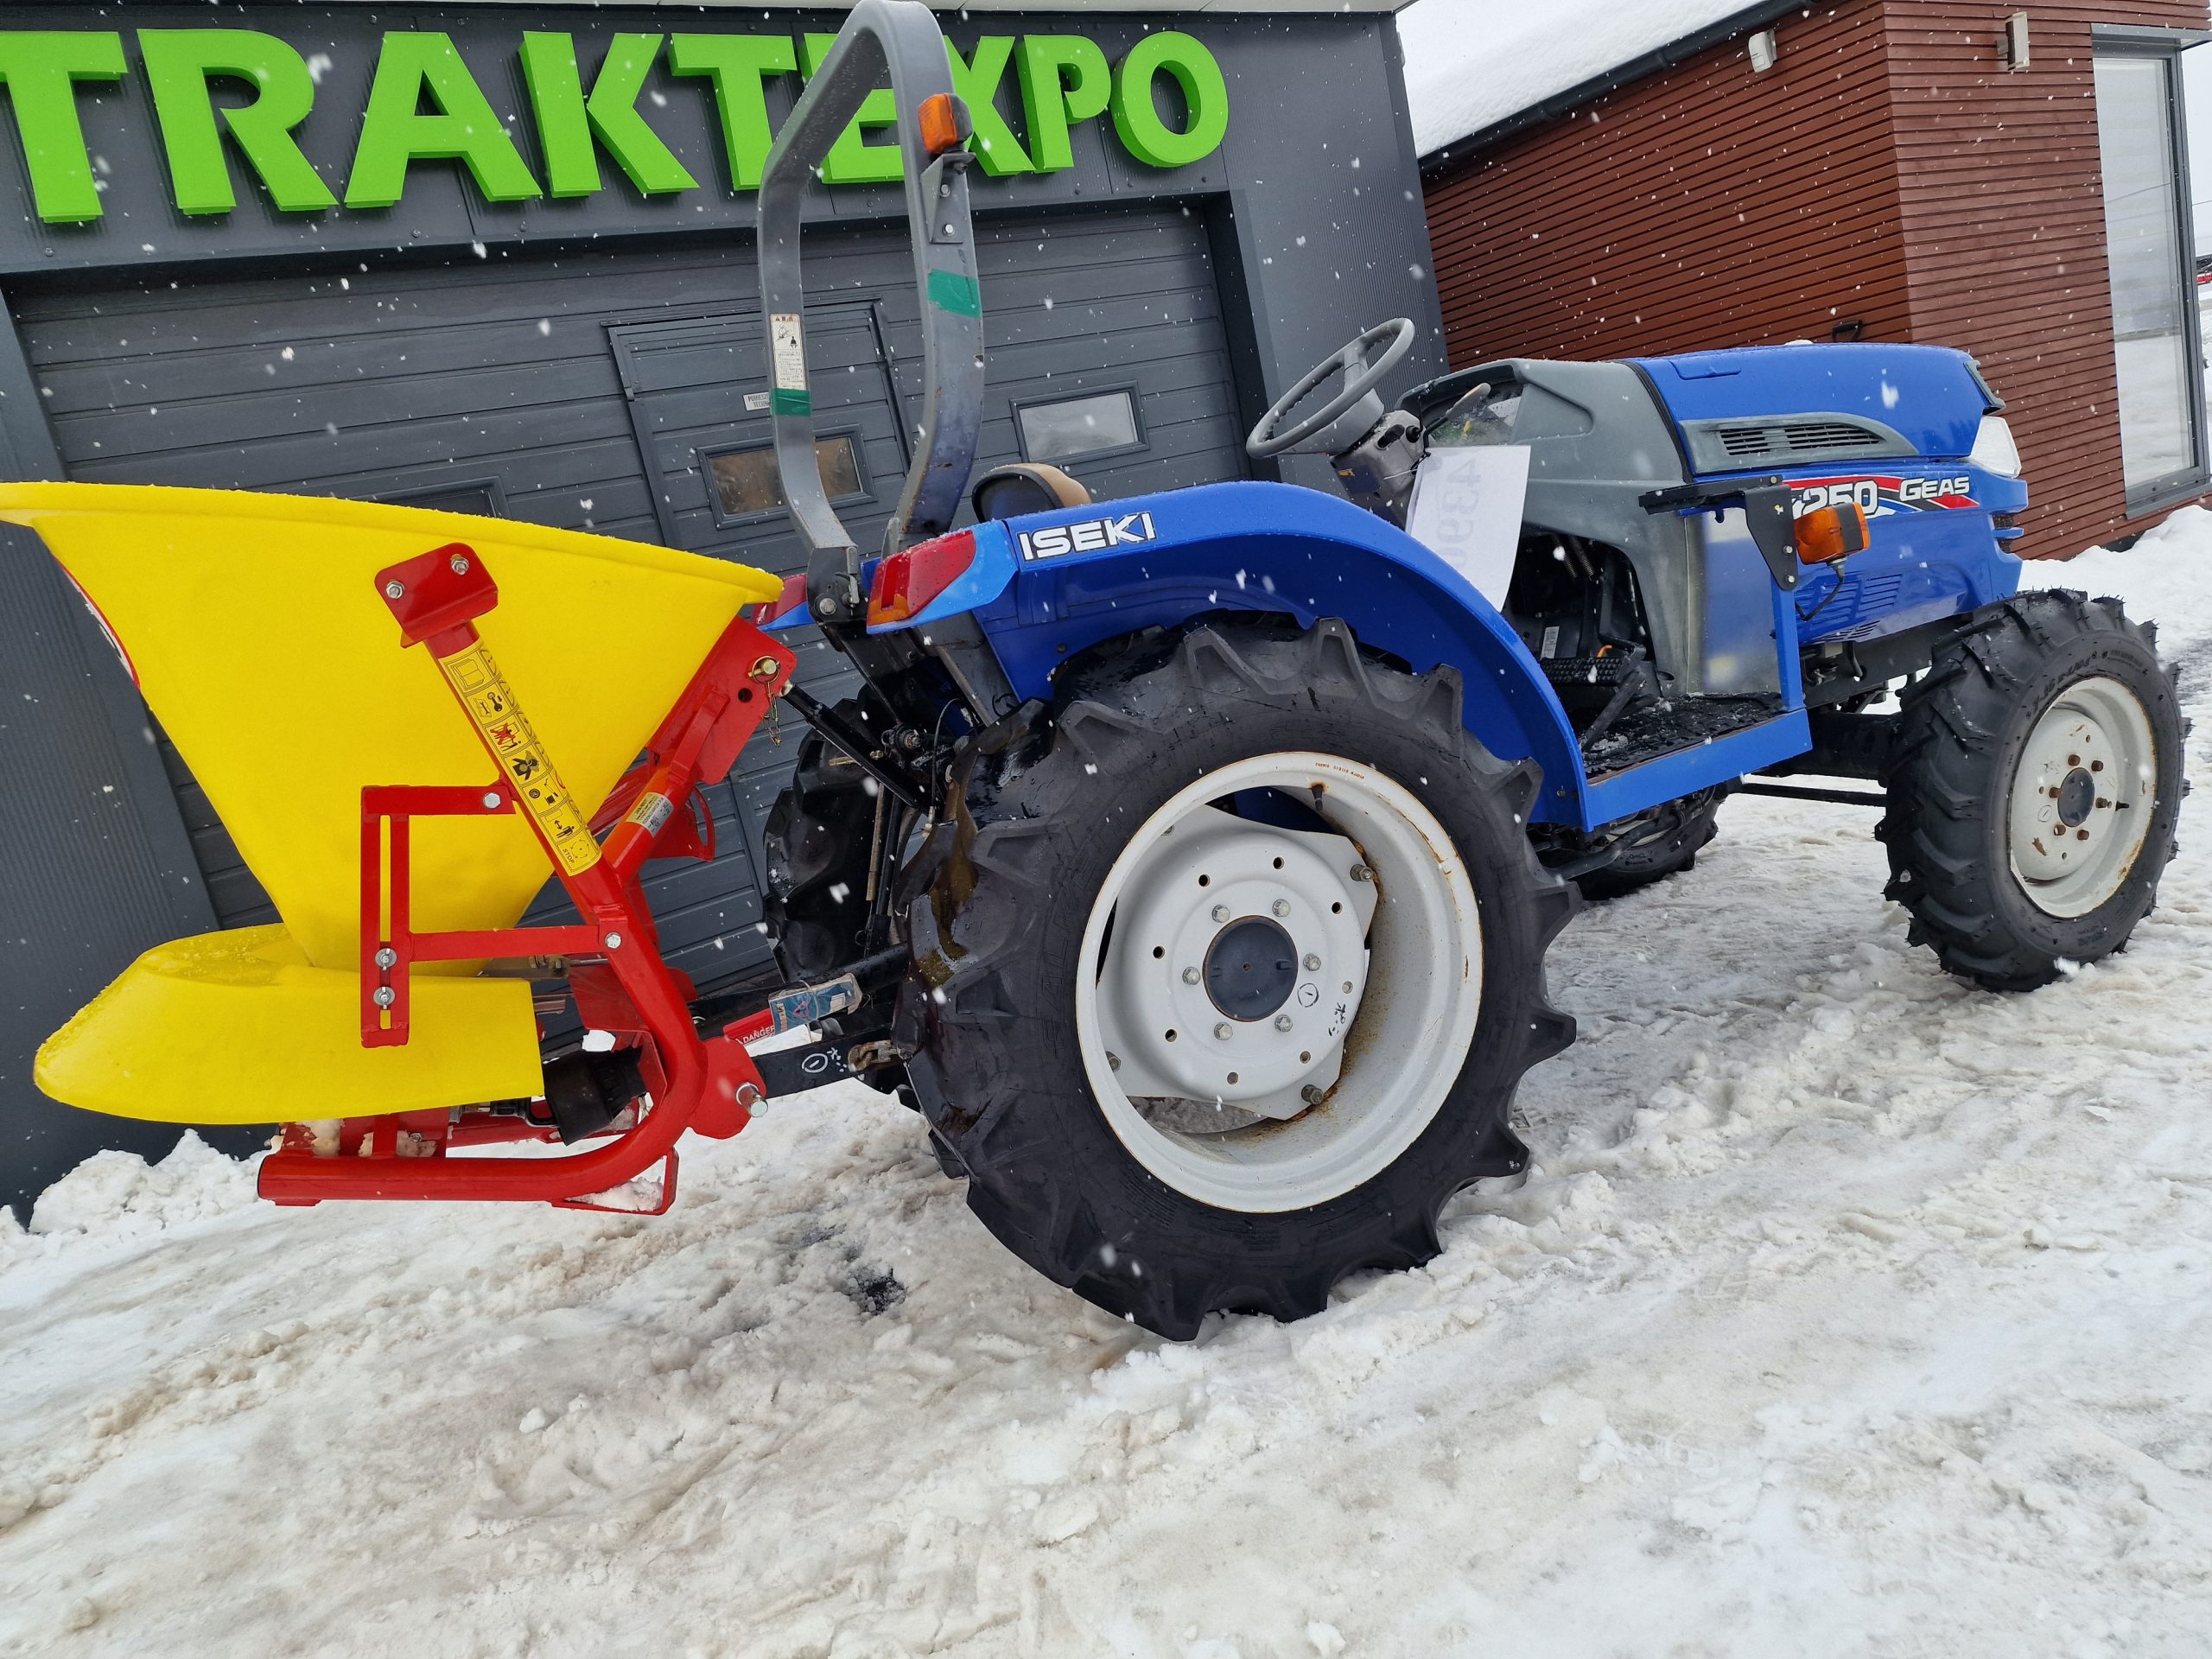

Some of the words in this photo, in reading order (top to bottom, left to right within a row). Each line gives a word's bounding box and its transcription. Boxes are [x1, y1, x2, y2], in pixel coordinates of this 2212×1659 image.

[1900, 476, 1970, 501] GEAS
[1018, 512, 1156, 562] ISEKI
[563, 848, 575, 863] STOP
